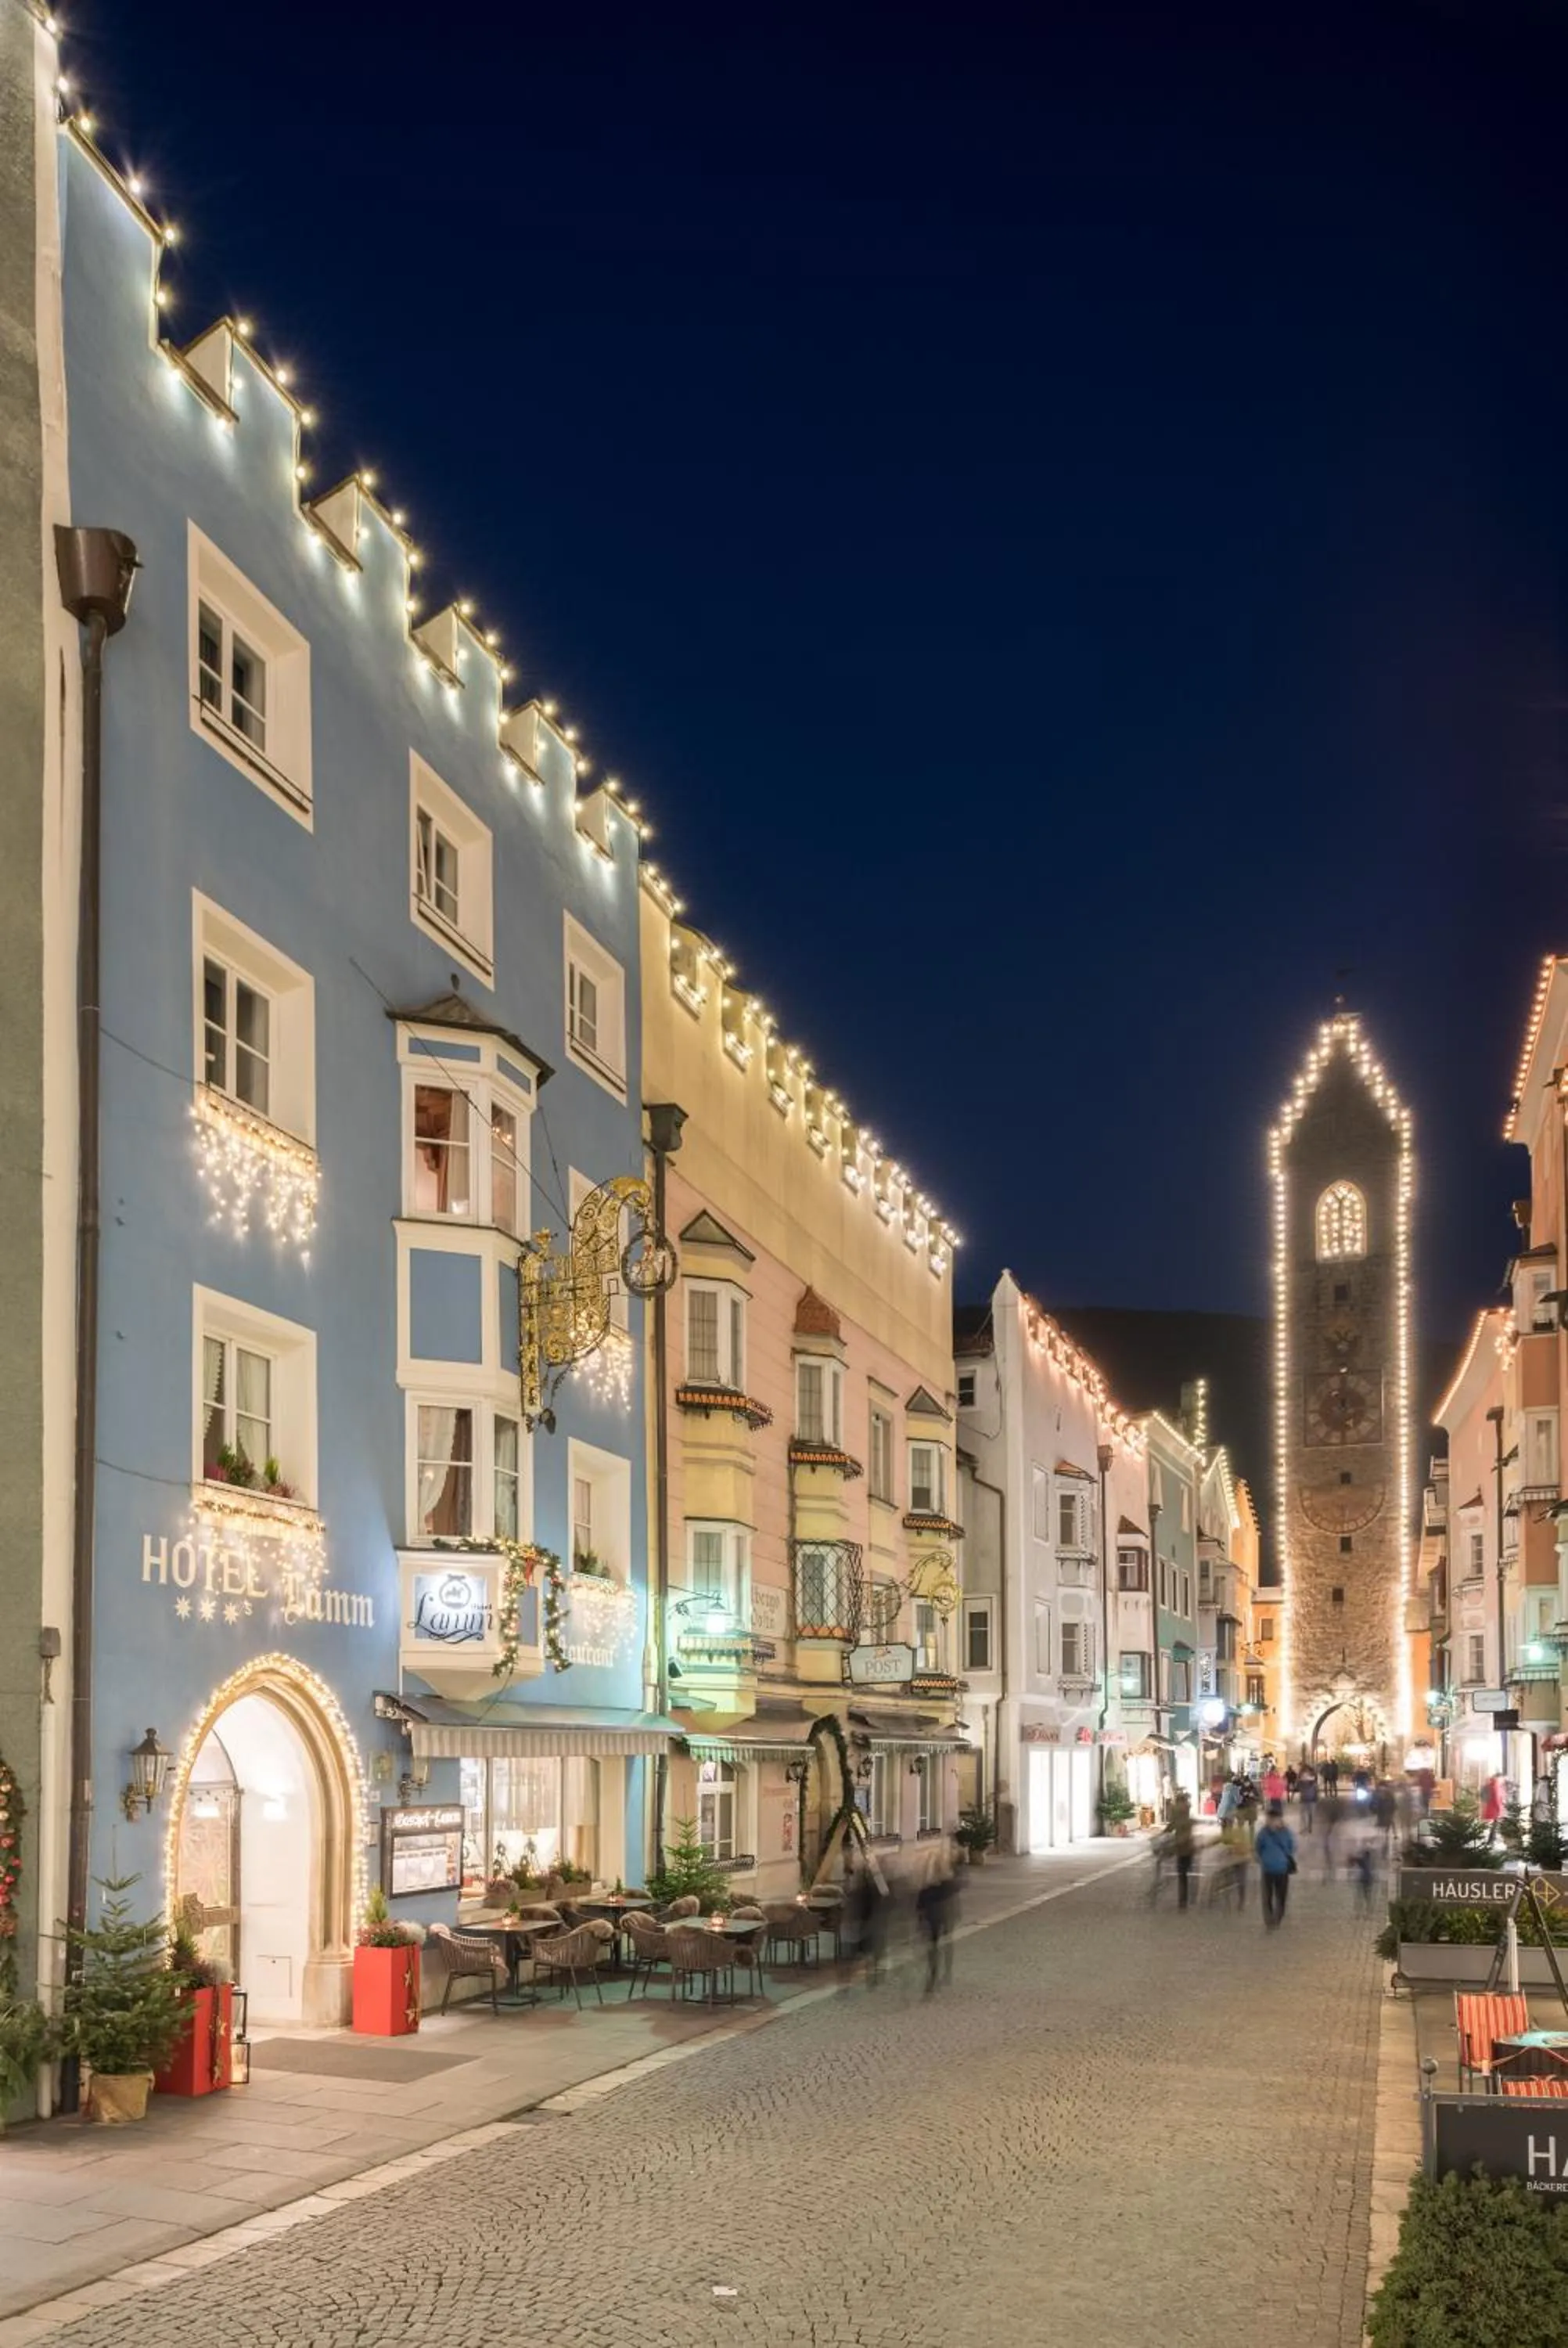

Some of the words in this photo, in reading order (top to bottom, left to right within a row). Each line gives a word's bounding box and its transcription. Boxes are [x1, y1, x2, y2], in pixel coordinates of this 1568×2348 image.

[142, 1534, 268, 1598] HOTEL
[282, 1572, 376, 1629] Lamm
[407, 1591, 492, 1644] Lamm
[865, 1659, 902, 1675] POST
[1433, 1878, 1516, 1900] HÄUSLER
[1528, 2134, 1568, 2177] H
